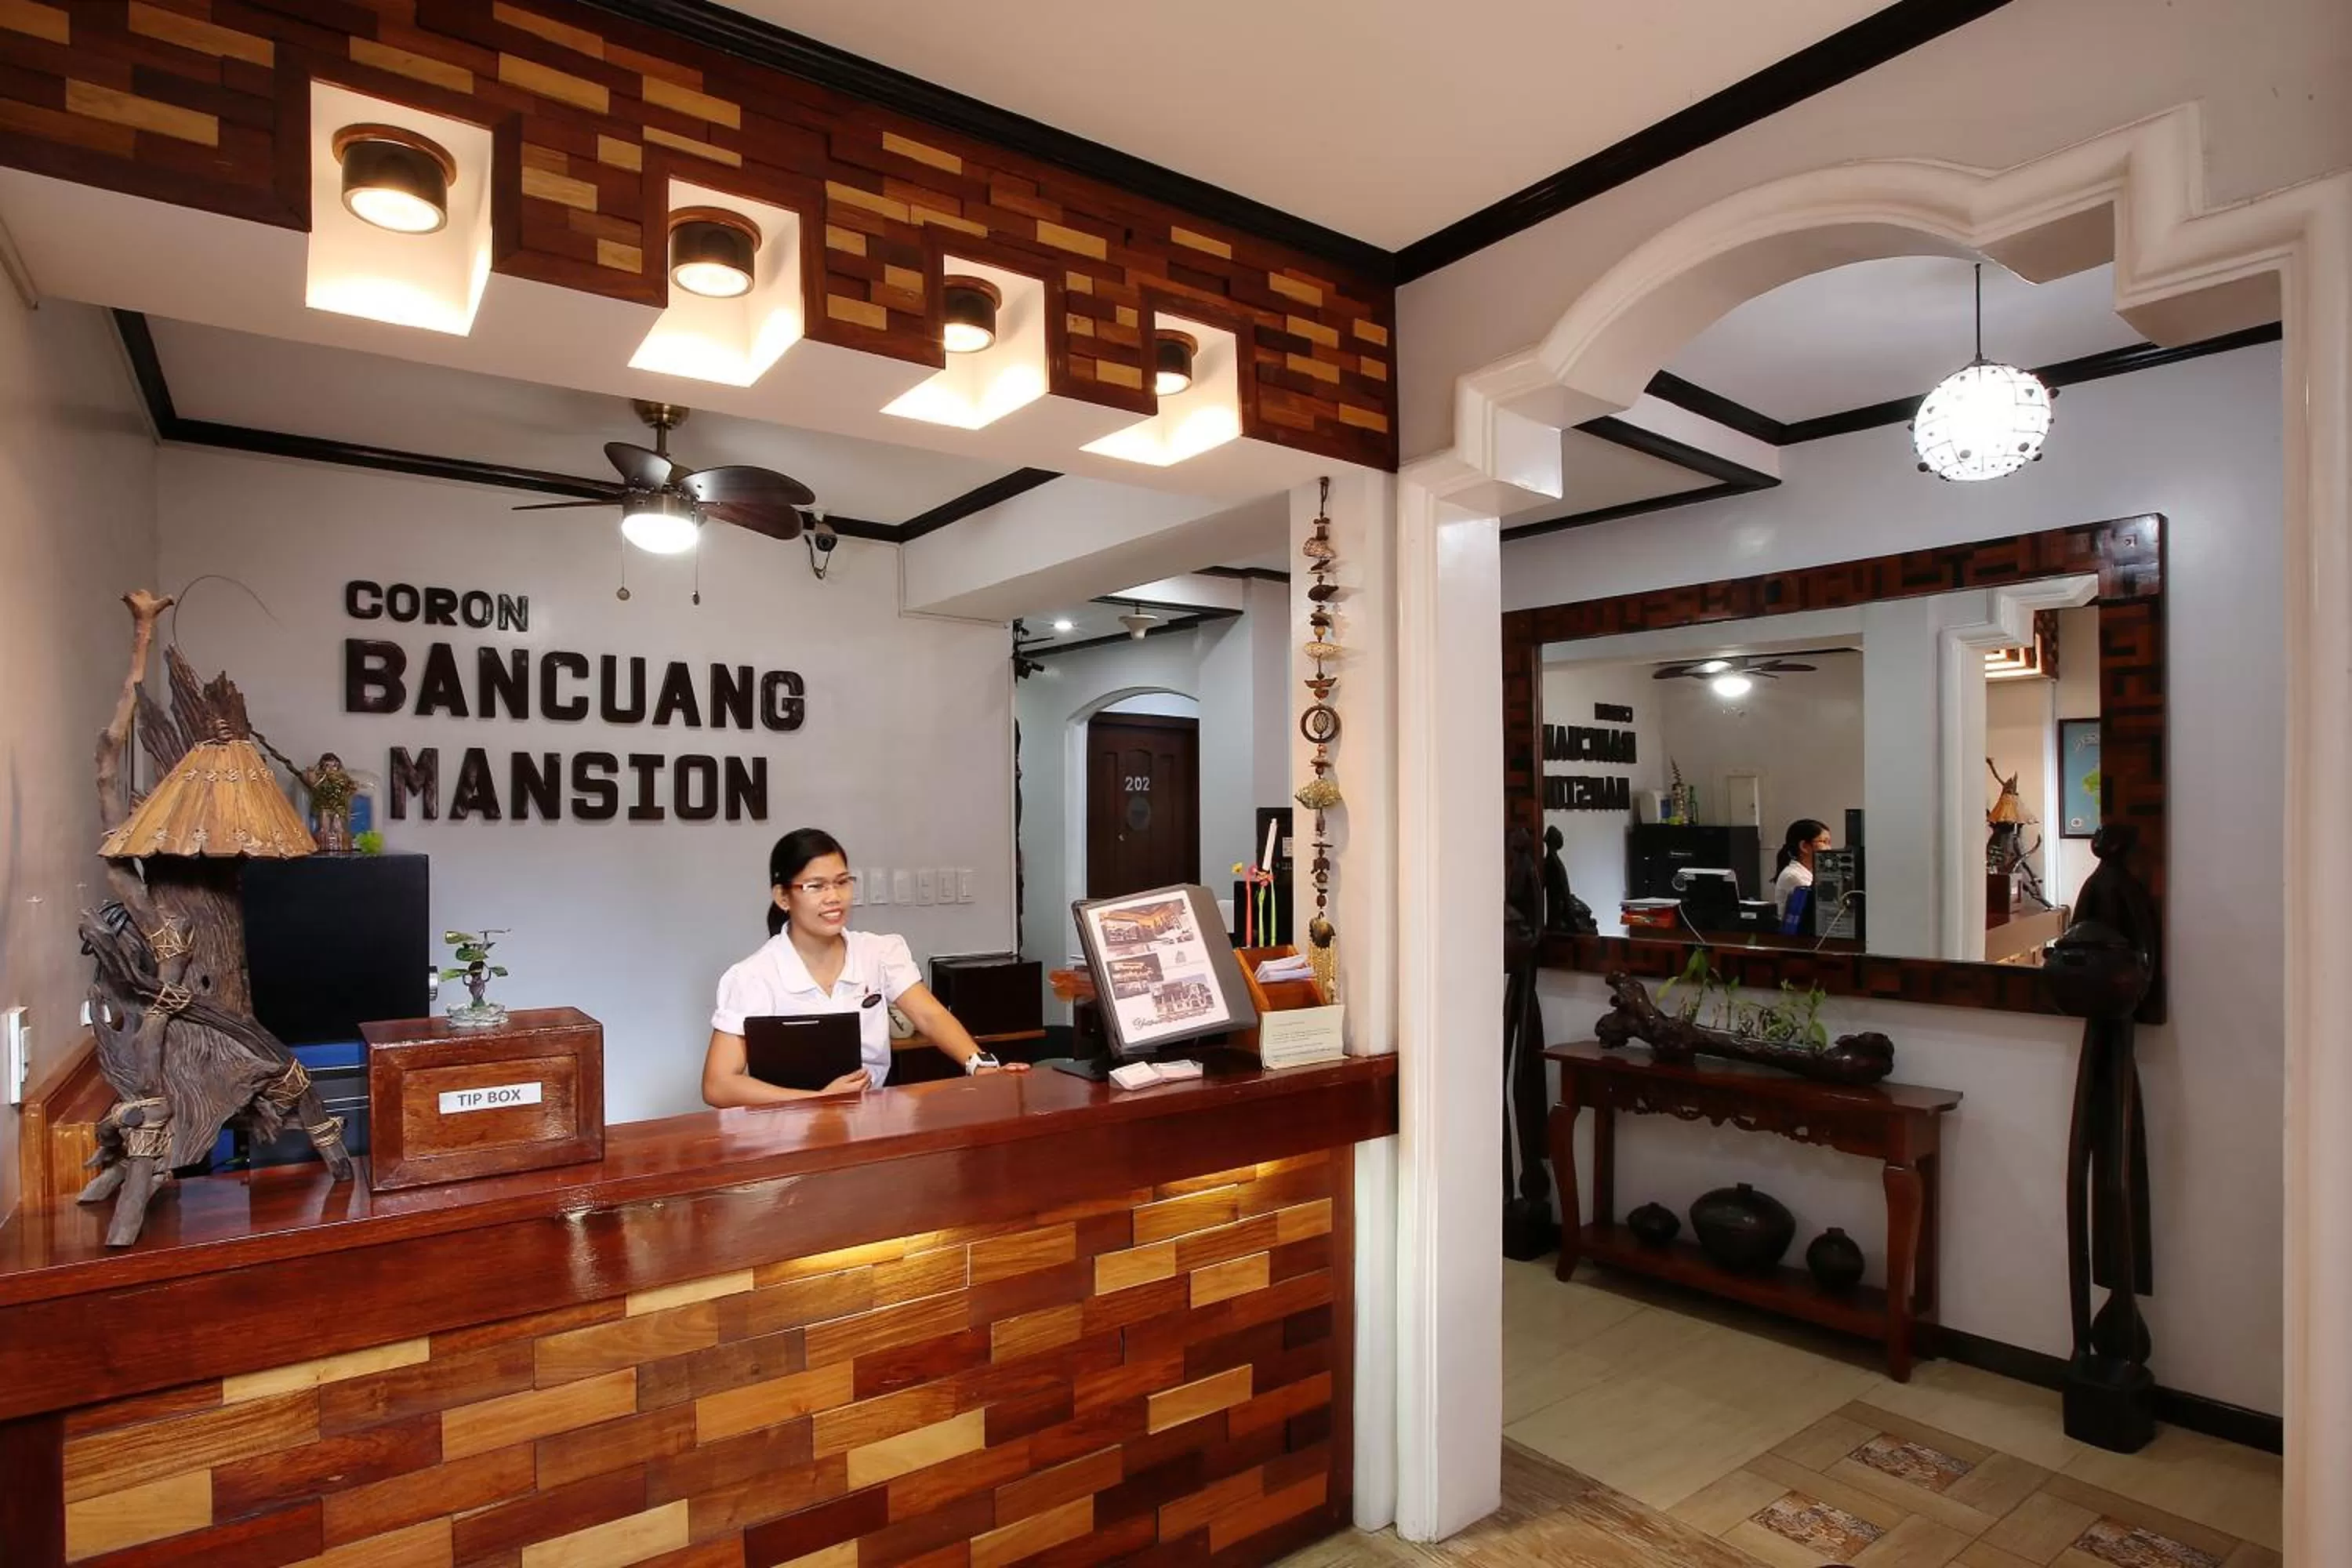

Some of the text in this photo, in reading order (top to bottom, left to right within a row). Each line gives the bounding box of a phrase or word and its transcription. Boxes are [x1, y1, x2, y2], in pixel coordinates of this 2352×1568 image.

[344, 579, 528, 632] CORON
[344, 637, 805, 731] BANCUANG
[389, 746, 768, 822] MANSION
[1124, 775, 1150, 791] 202
[457, 1089, 521, 1106] TIP BOX
